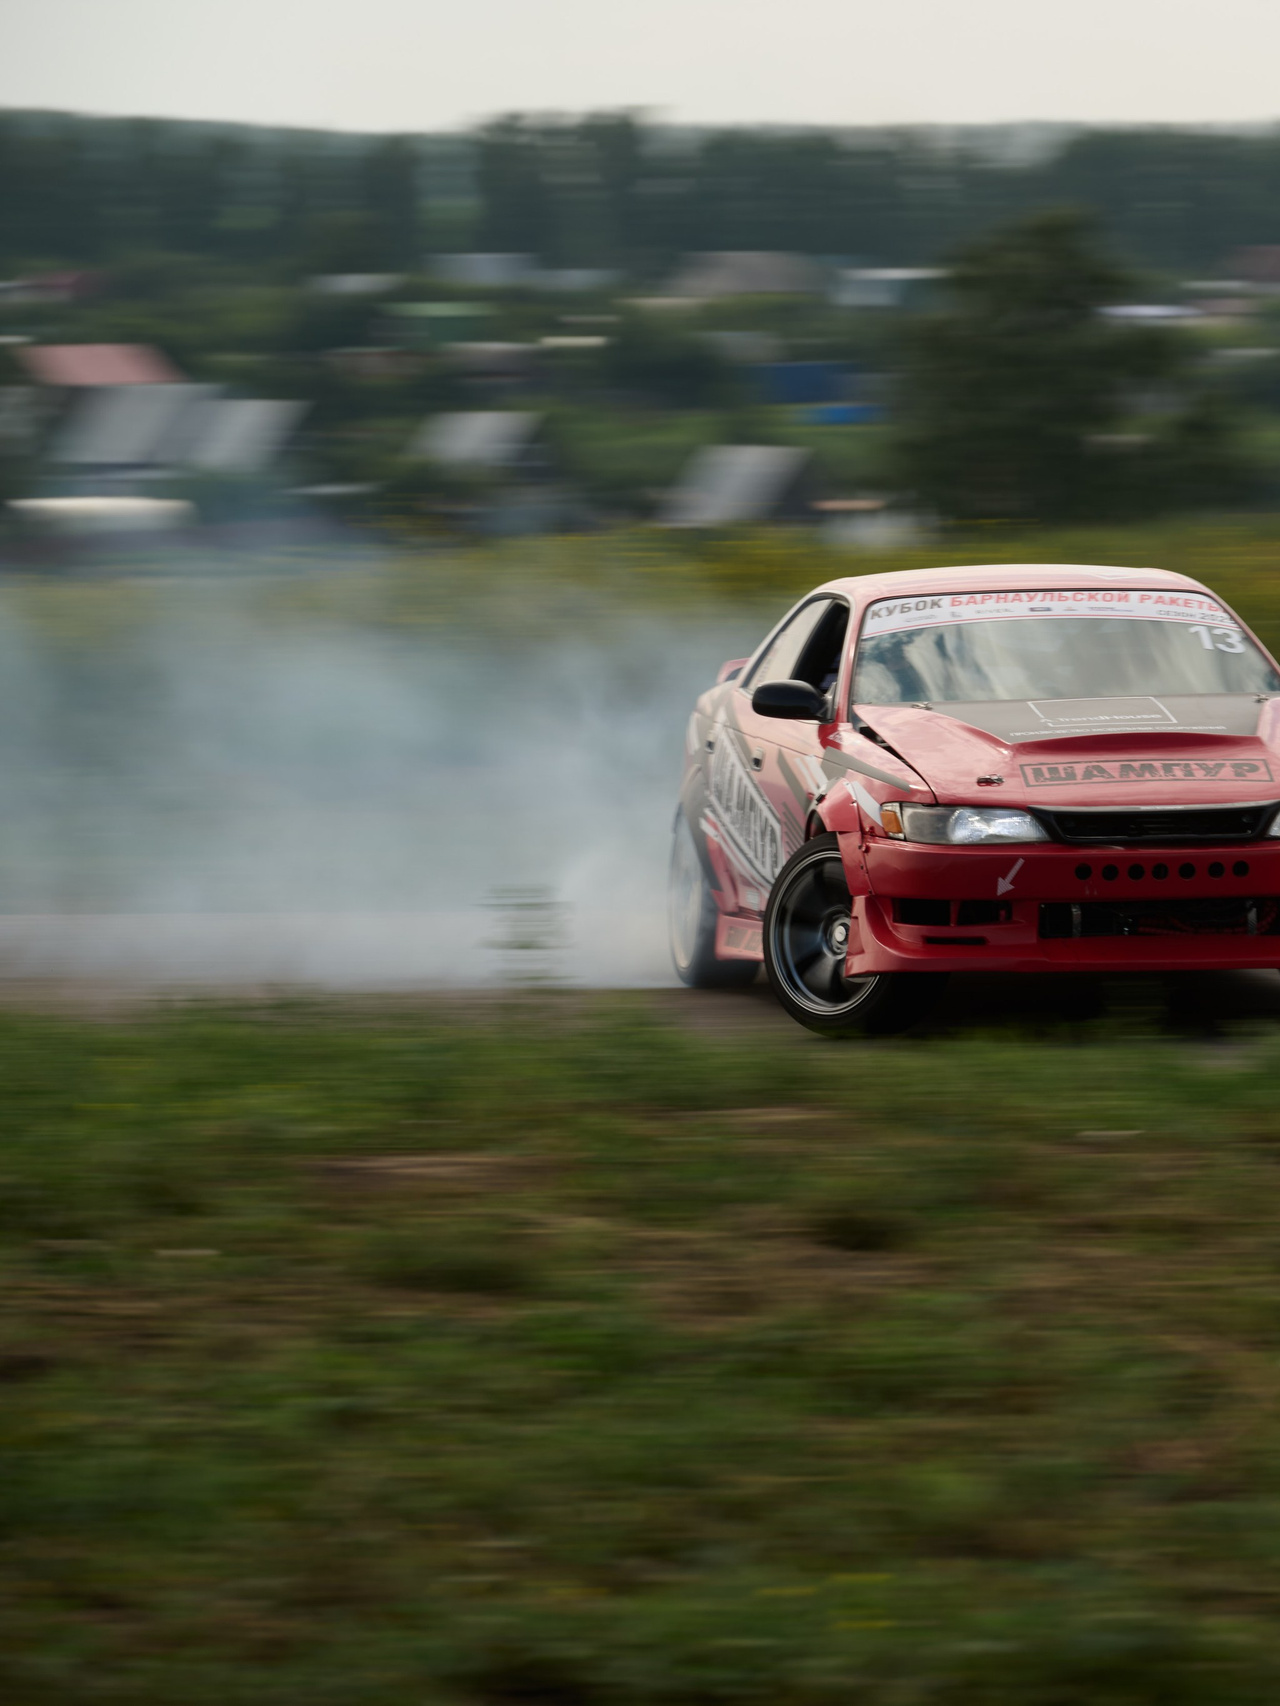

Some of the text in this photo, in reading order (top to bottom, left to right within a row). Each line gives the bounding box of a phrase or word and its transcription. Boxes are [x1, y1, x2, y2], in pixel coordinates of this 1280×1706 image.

[870, 598, 943, 620] КУБОК
[949, 592, 1130, 607] БАРНАУЛЬСКОЙ
[1188, 625, 1246, 654] 13
[1030, 762, 1261, 783] ШАМПУР
